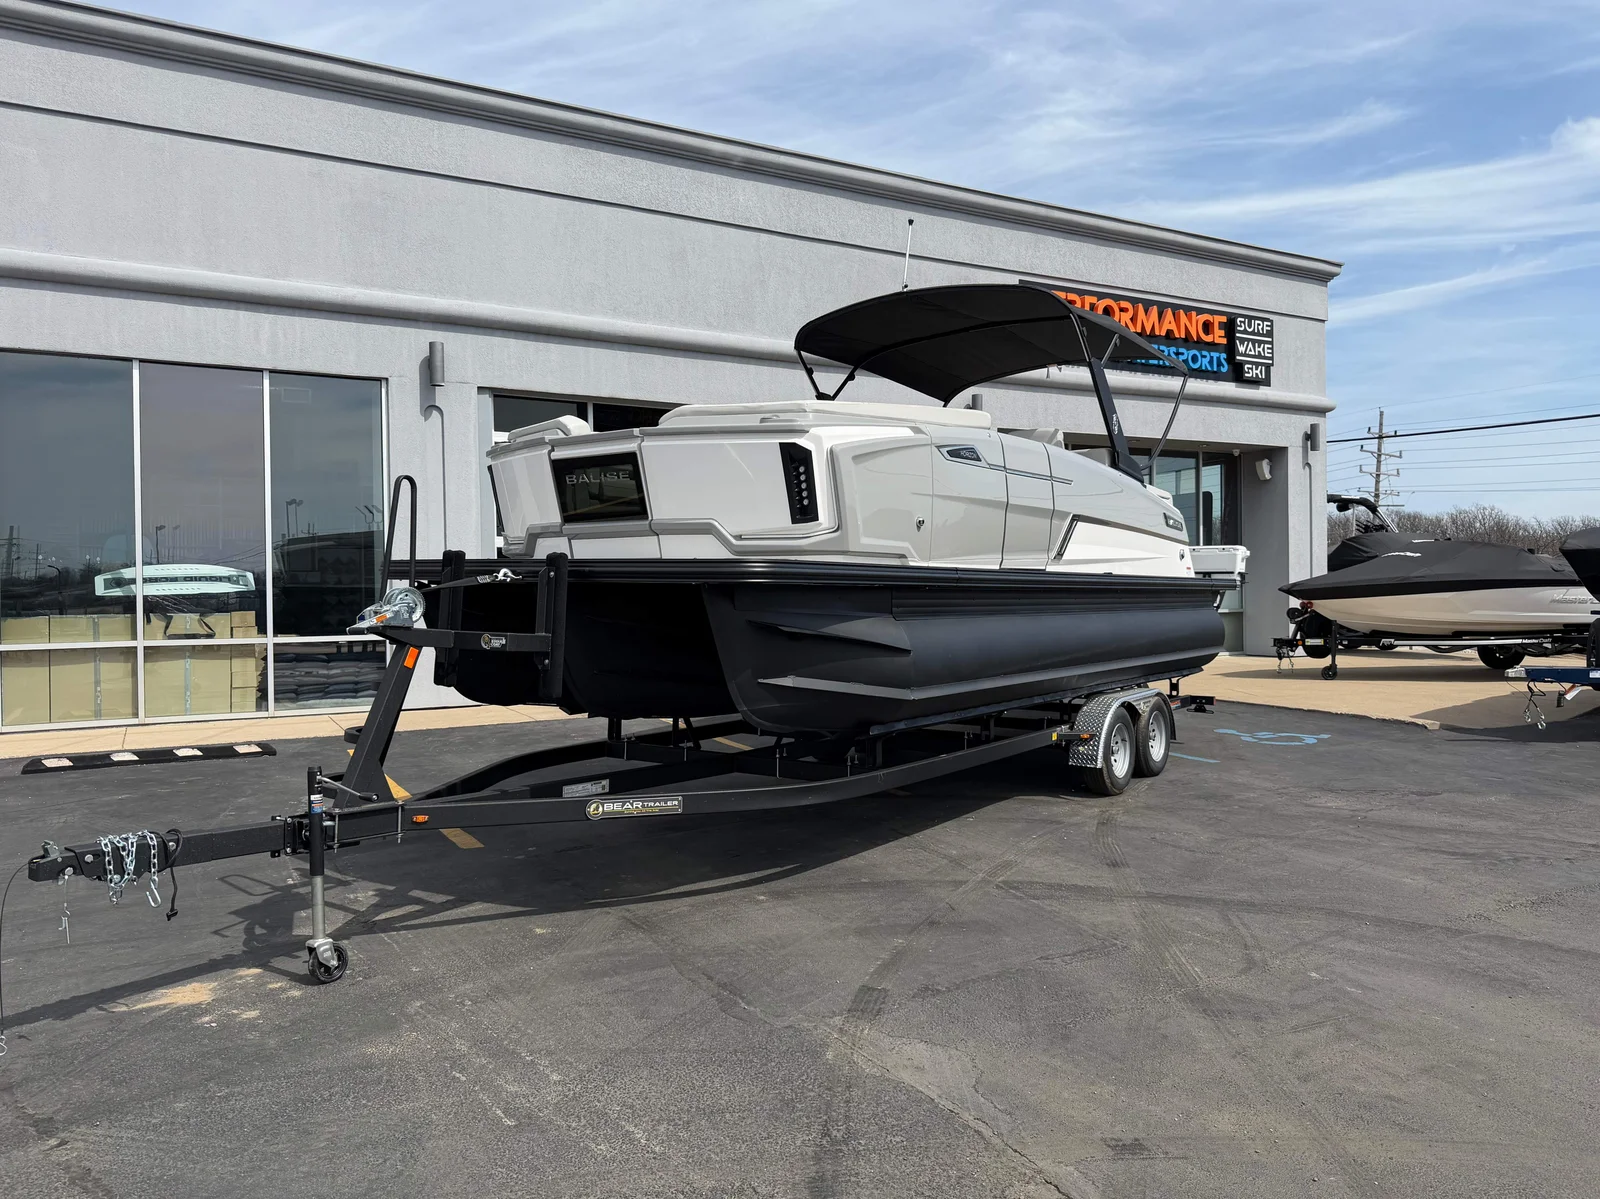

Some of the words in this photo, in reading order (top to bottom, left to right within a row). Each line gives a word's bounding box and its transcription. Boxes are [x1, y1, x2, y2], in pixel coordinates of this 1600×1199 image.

[1051, 290, 1228, 345] ORMANCE
[1236, 317, 1272, 334] SURF
[1235, 340, 1273, 357] WAKE
[1134, 343, 1229, 373] RSPORTS
[1244, 364, 1266, 379] SKI
[565, 470, 631, 485] BALISE
[603, 801, 643, 811] BEAR
[643, 800, 679, 808] TRAILER
